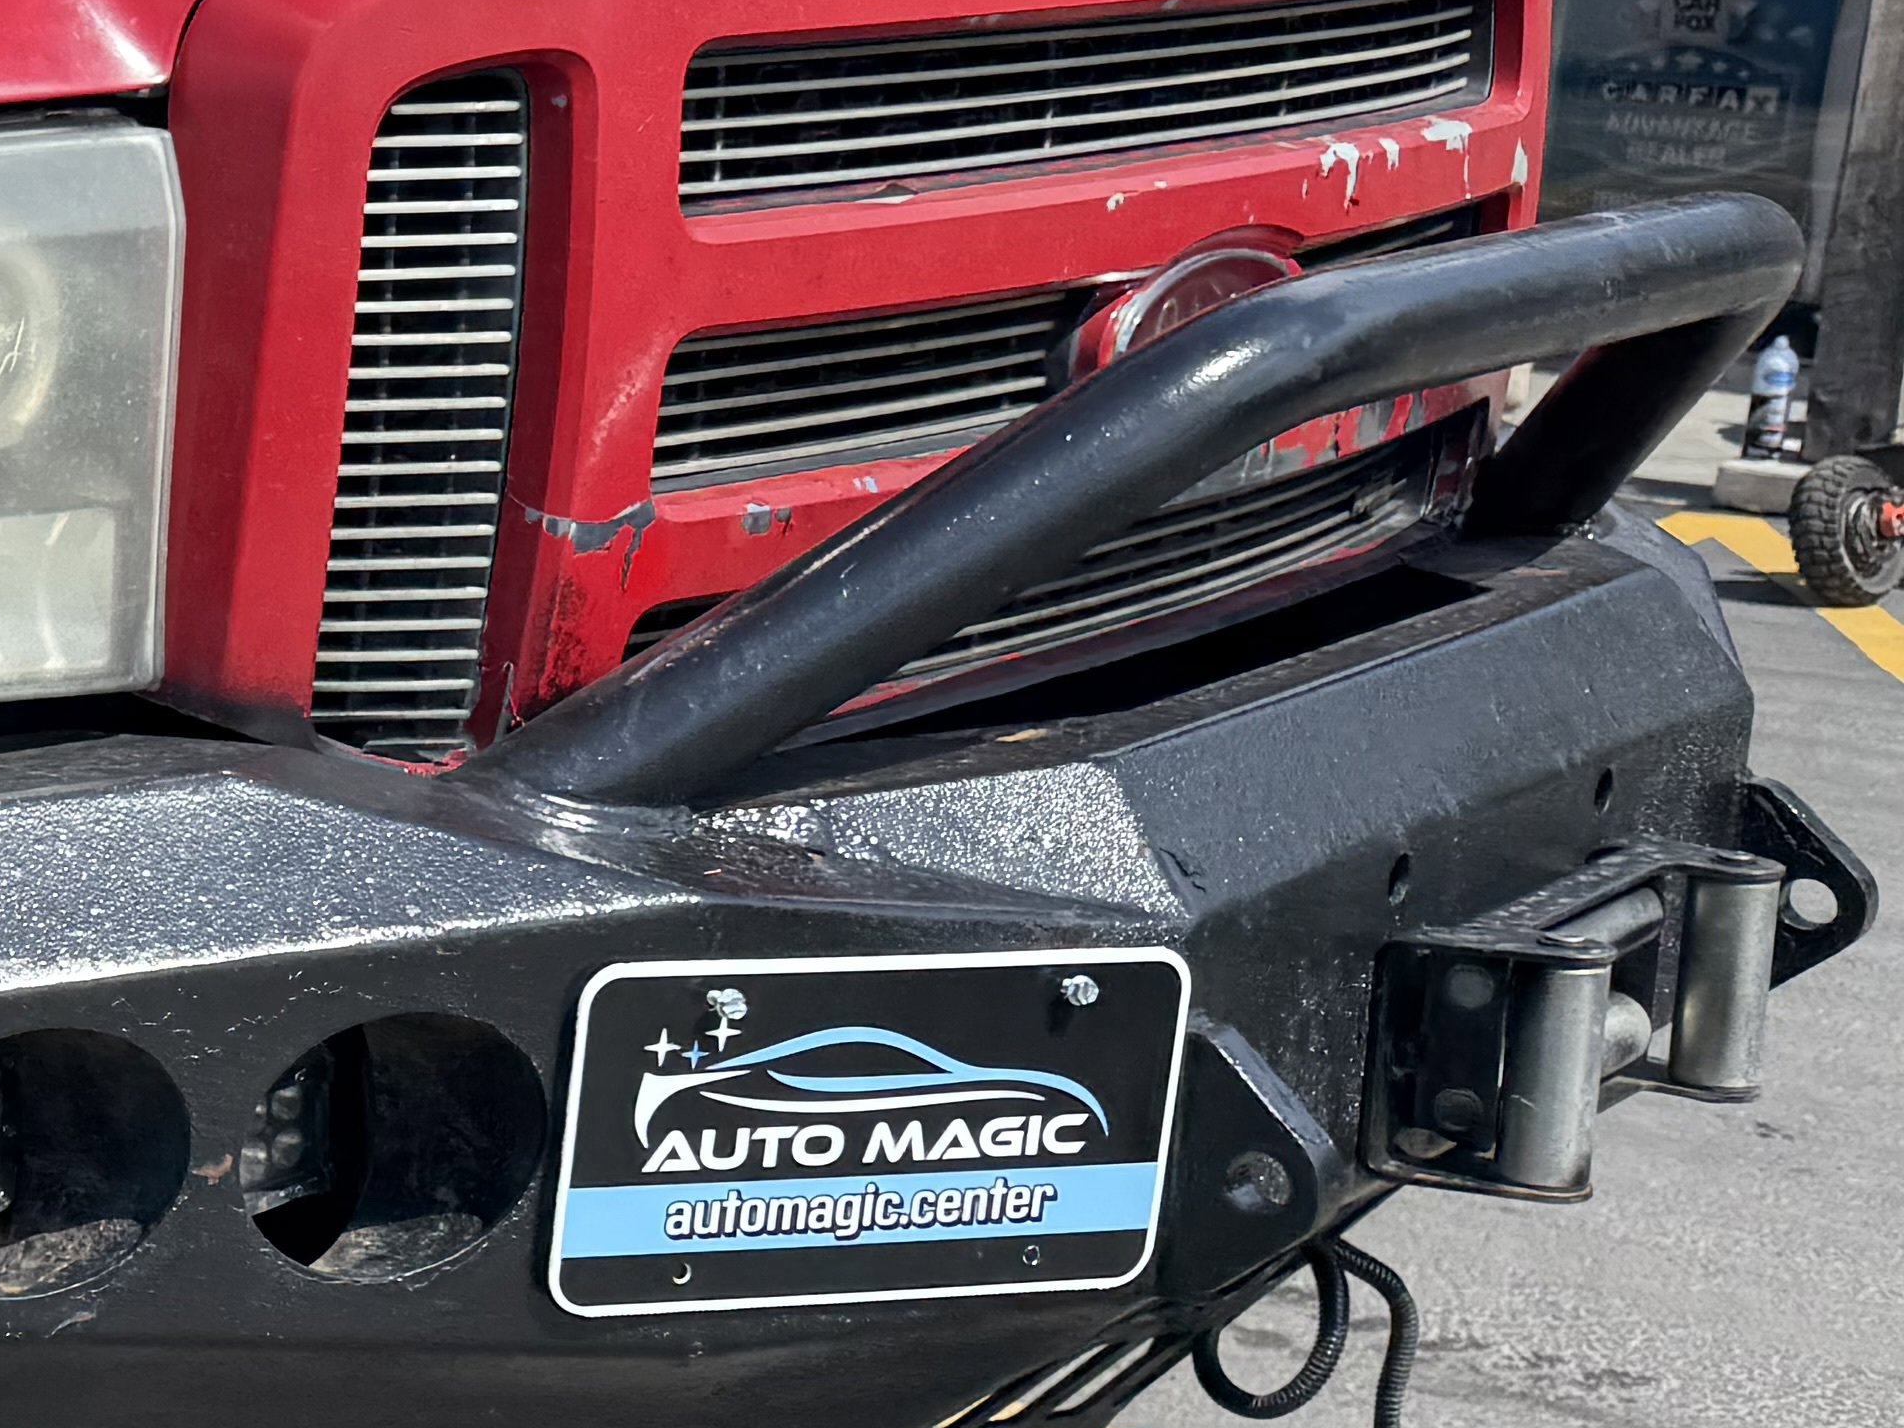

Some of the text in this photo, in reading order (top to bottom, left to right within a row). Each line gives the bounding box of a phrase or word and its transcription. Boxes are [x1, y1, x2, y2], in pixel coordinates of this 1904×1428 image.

[1601, 81, 1780, 115] CARFAX
[641, 1112, 1090, 1173] AUTO MAGIC
[664, 1176, 1058, 1242] automagic.center
